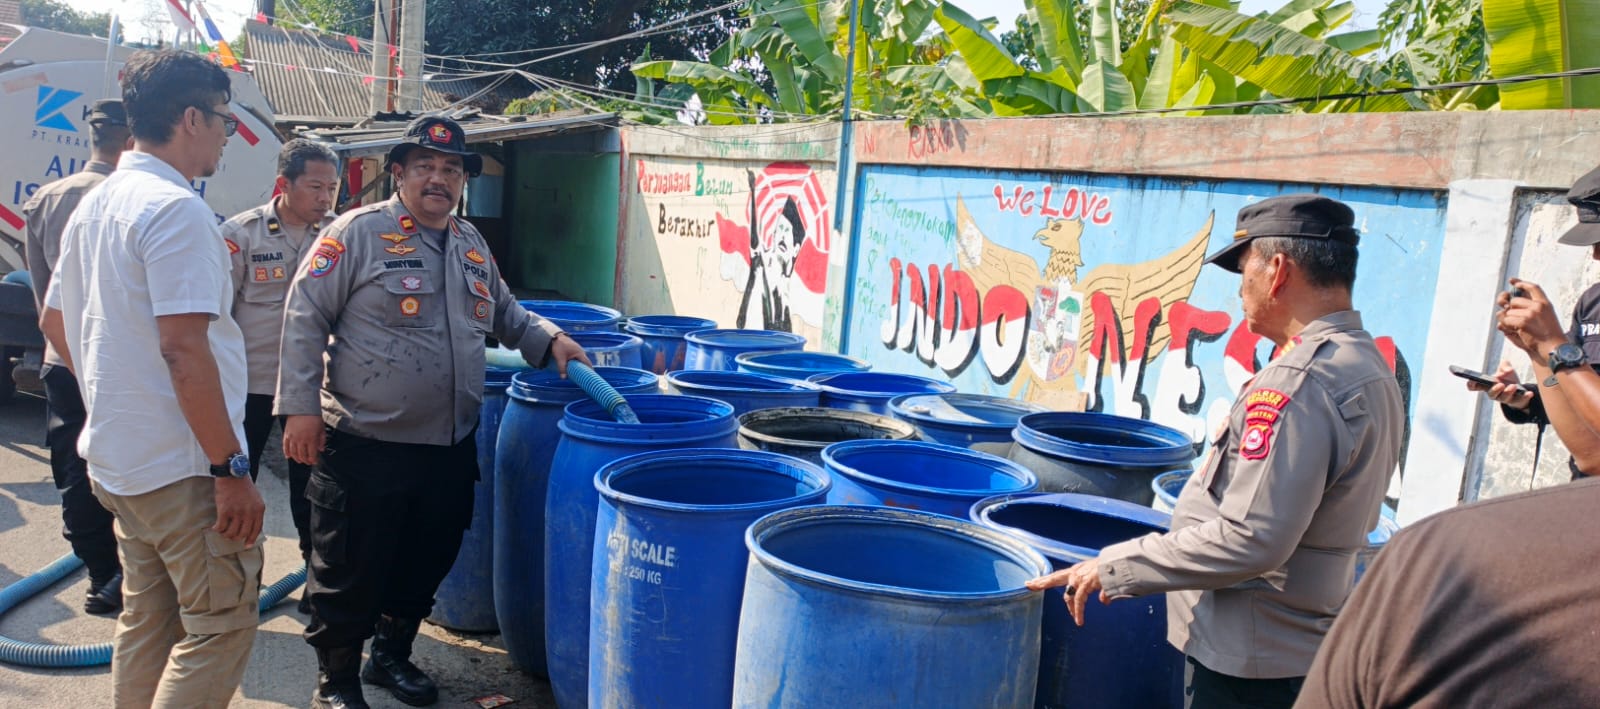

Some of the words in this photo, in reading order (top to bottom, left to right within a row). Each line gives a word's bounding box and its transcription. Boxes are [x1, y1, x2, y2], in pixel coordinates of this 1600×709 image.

[658, 202, 715, 238] Berakhir
[464, 262, 488, 281] POLRI
[631, 538, 676, 568] SCALE
[647, 569, 662, 585] KG
